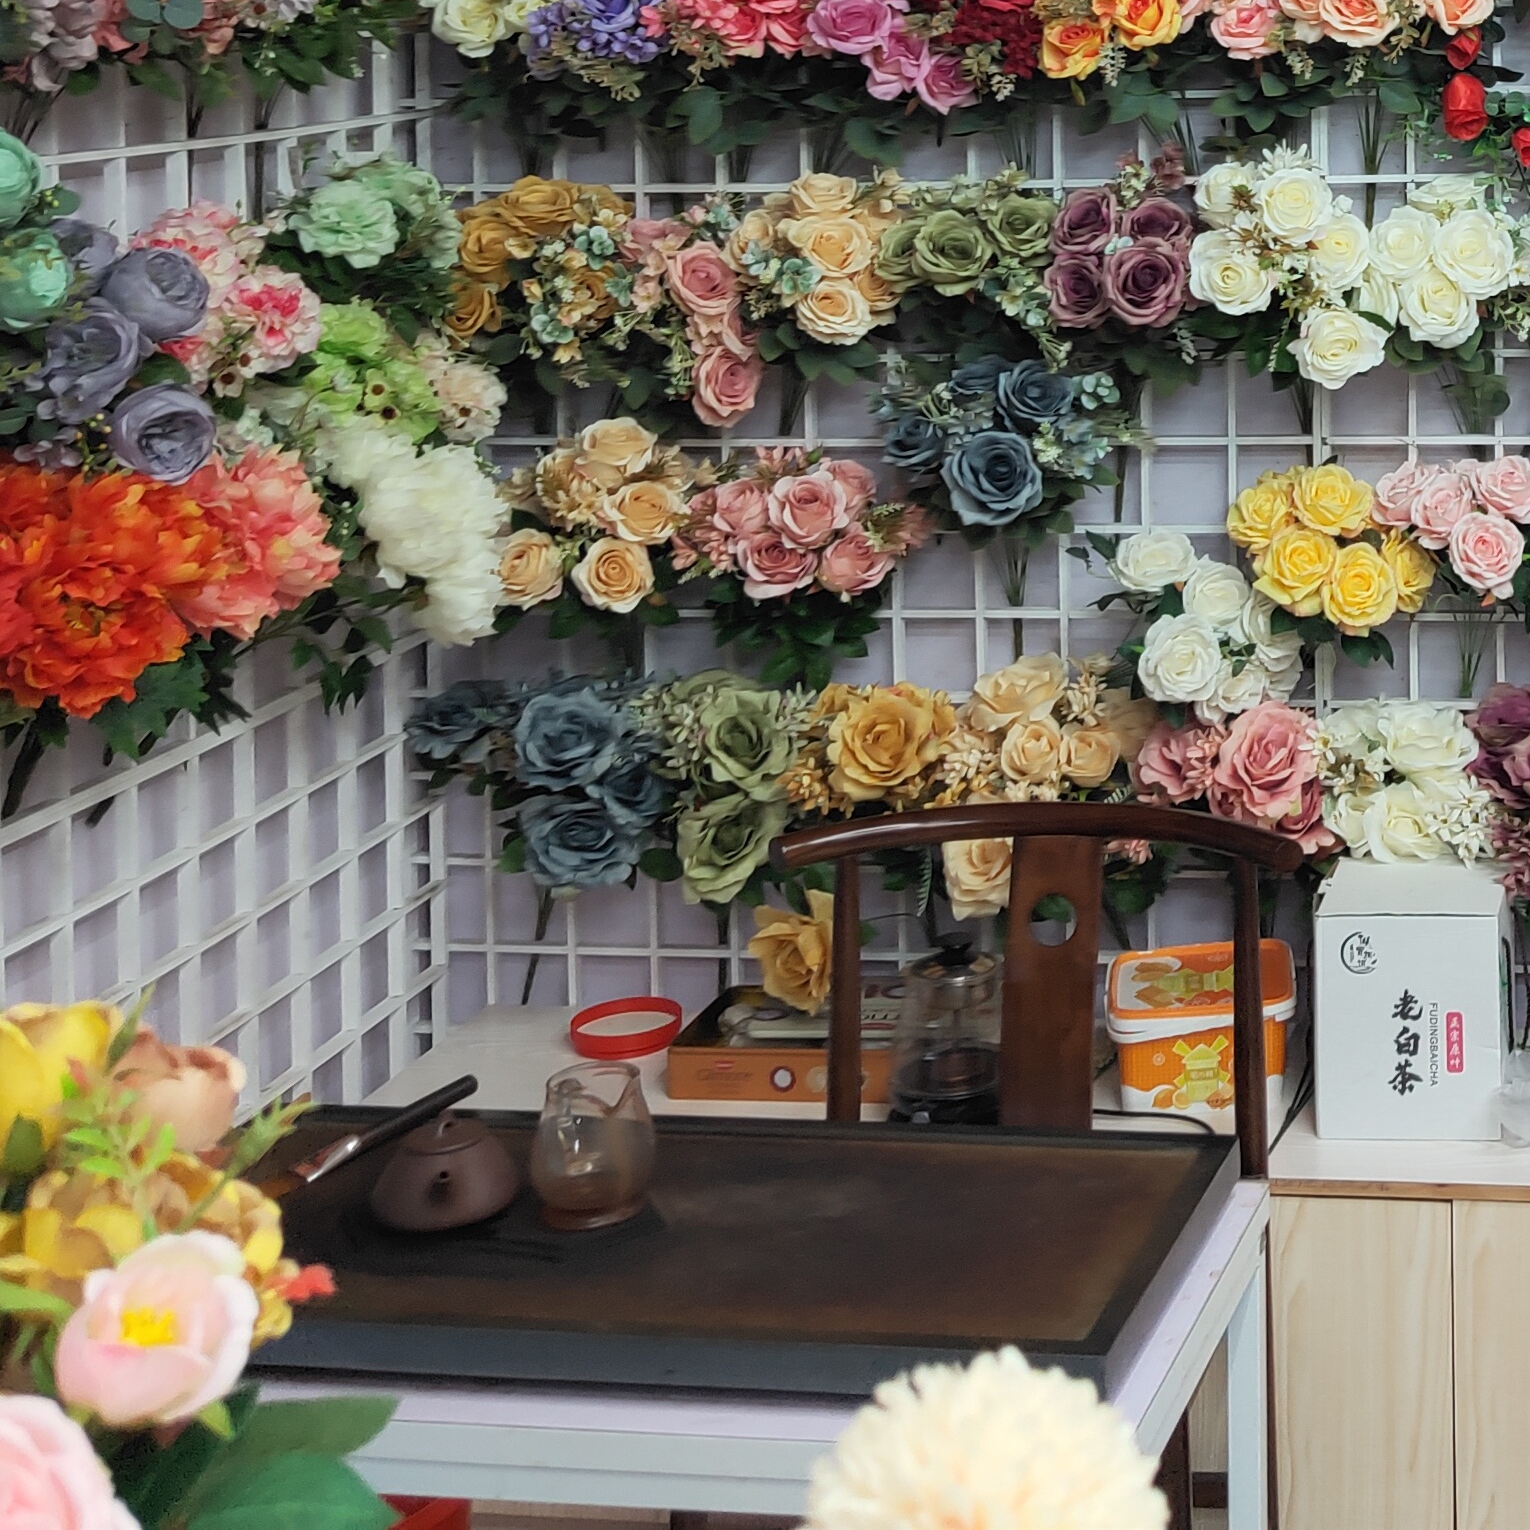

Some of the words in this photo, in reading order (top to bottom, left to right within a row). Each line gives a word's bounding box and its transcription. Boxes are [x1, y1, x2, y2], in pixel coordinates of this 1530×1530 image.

[1388, 988, 1424, 1096] 老白茶
[1429, 1002, 1439, 1087] FUDINGBAICHA
